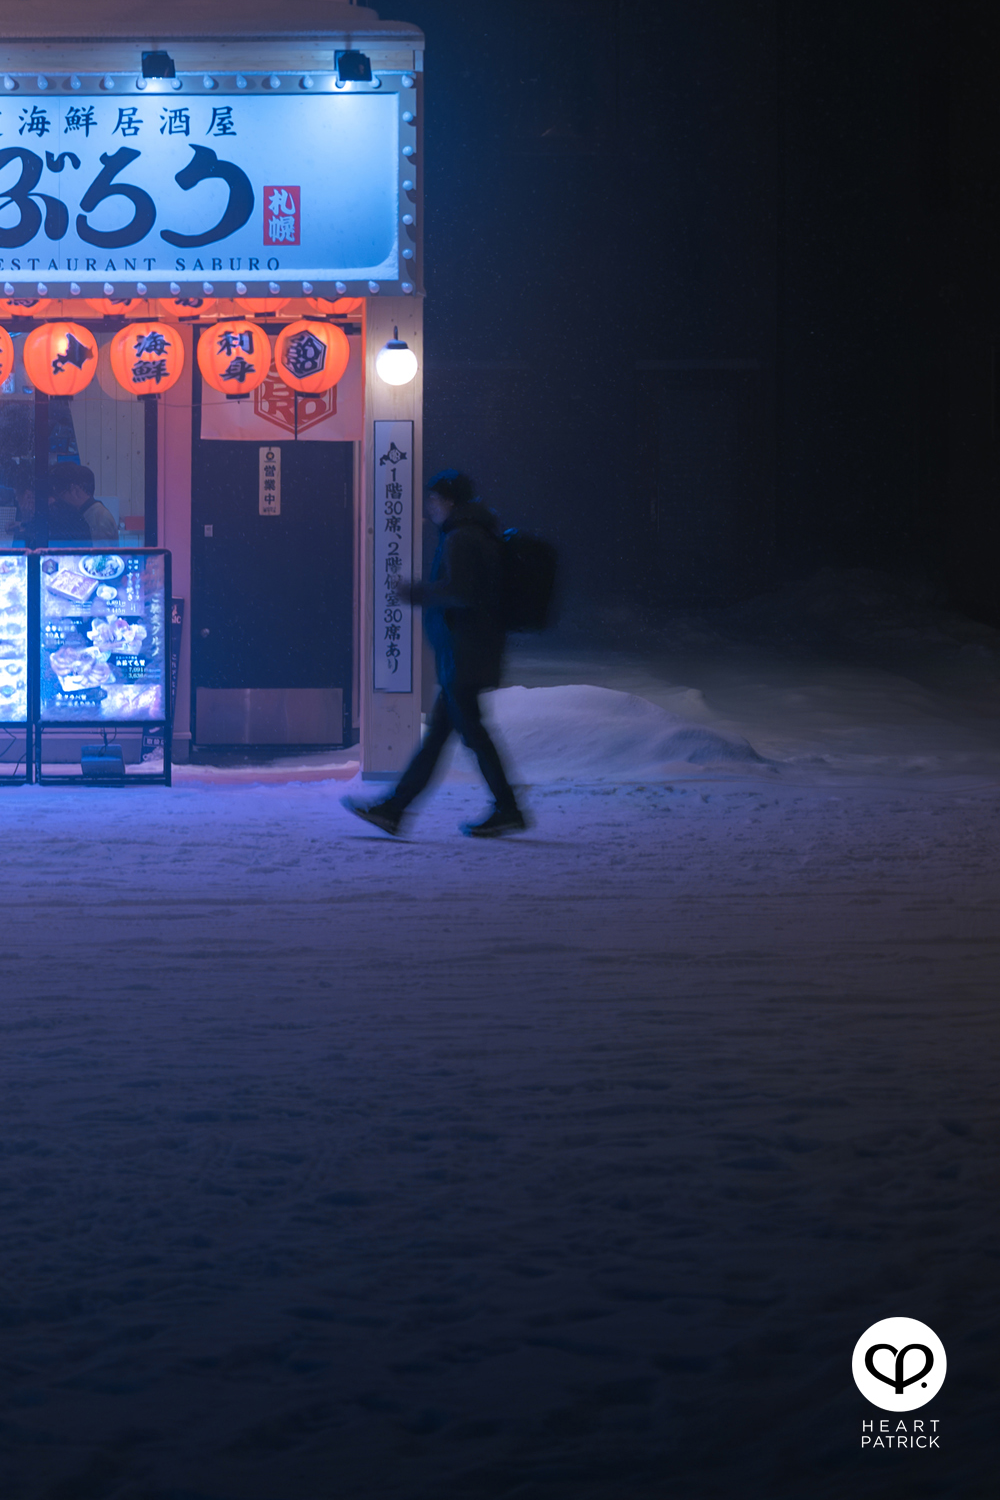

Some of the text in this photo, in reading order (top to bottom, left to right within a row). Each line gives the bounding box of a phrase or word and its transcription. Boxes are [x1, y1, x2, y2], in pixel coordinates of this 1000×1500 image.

[267, 189, 296, 242] 札幌
[175, 257, 280, 271] SABURO
[132, 331, 171, 385] 海鮮
[264, 464, 276, 506] 営業中
